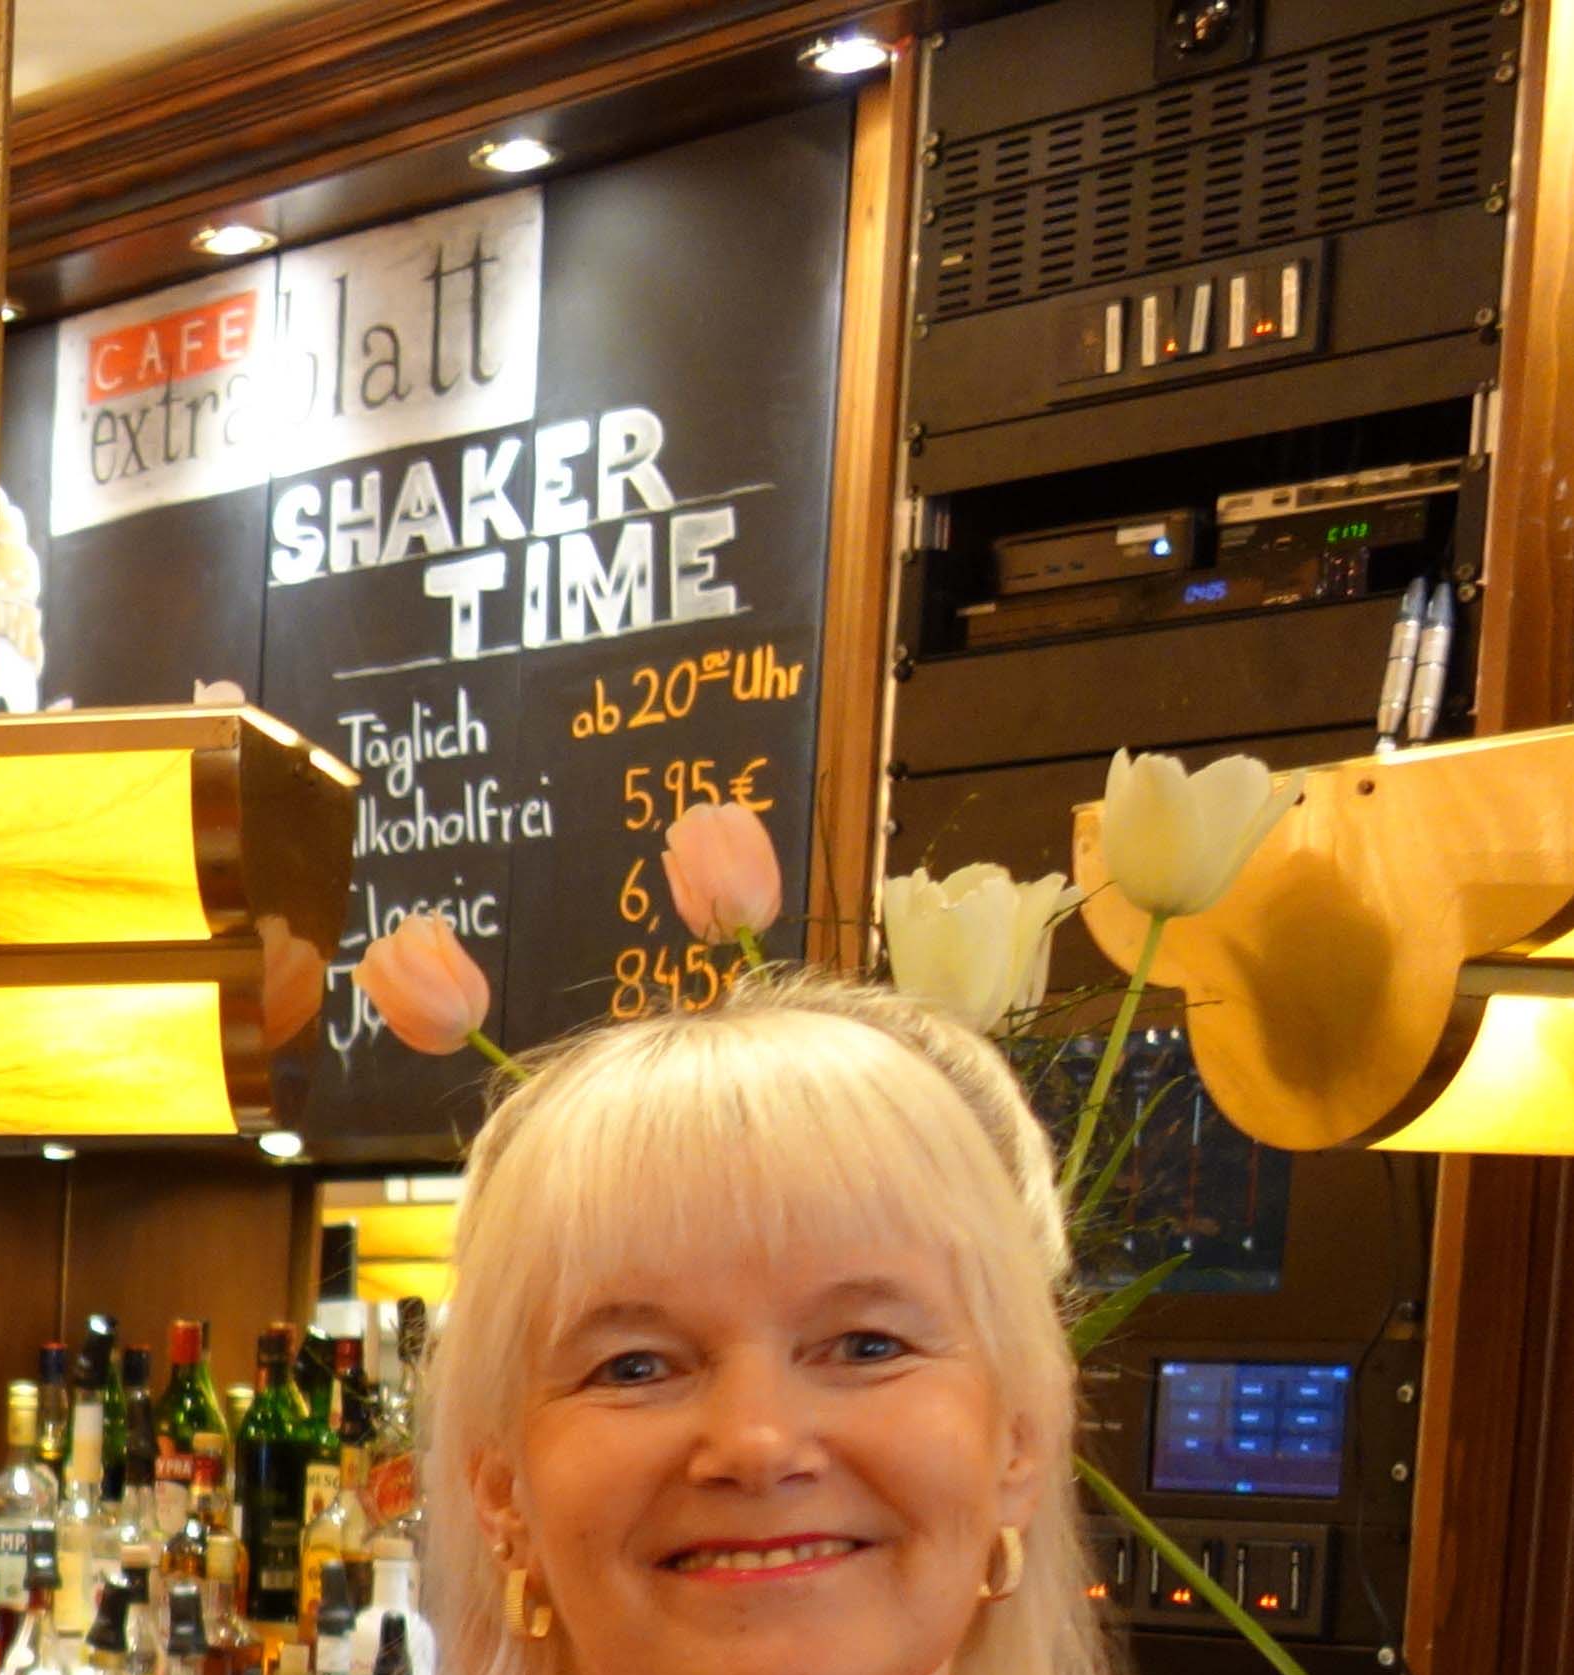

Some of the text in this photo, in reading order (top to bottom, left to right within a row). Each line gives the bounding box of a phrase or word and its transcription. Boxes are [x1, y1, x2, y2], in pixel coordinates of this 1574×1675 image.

[270, 406, 677, 583] SHAKER
[423, 506, 738, 660] TIME
[338, 687, 490, 800] Täglich
[571, 679, 622, 739] ab
[732, 645, 804, 701] Uhr
[352, 772, 553, 858] lkoholfrei
